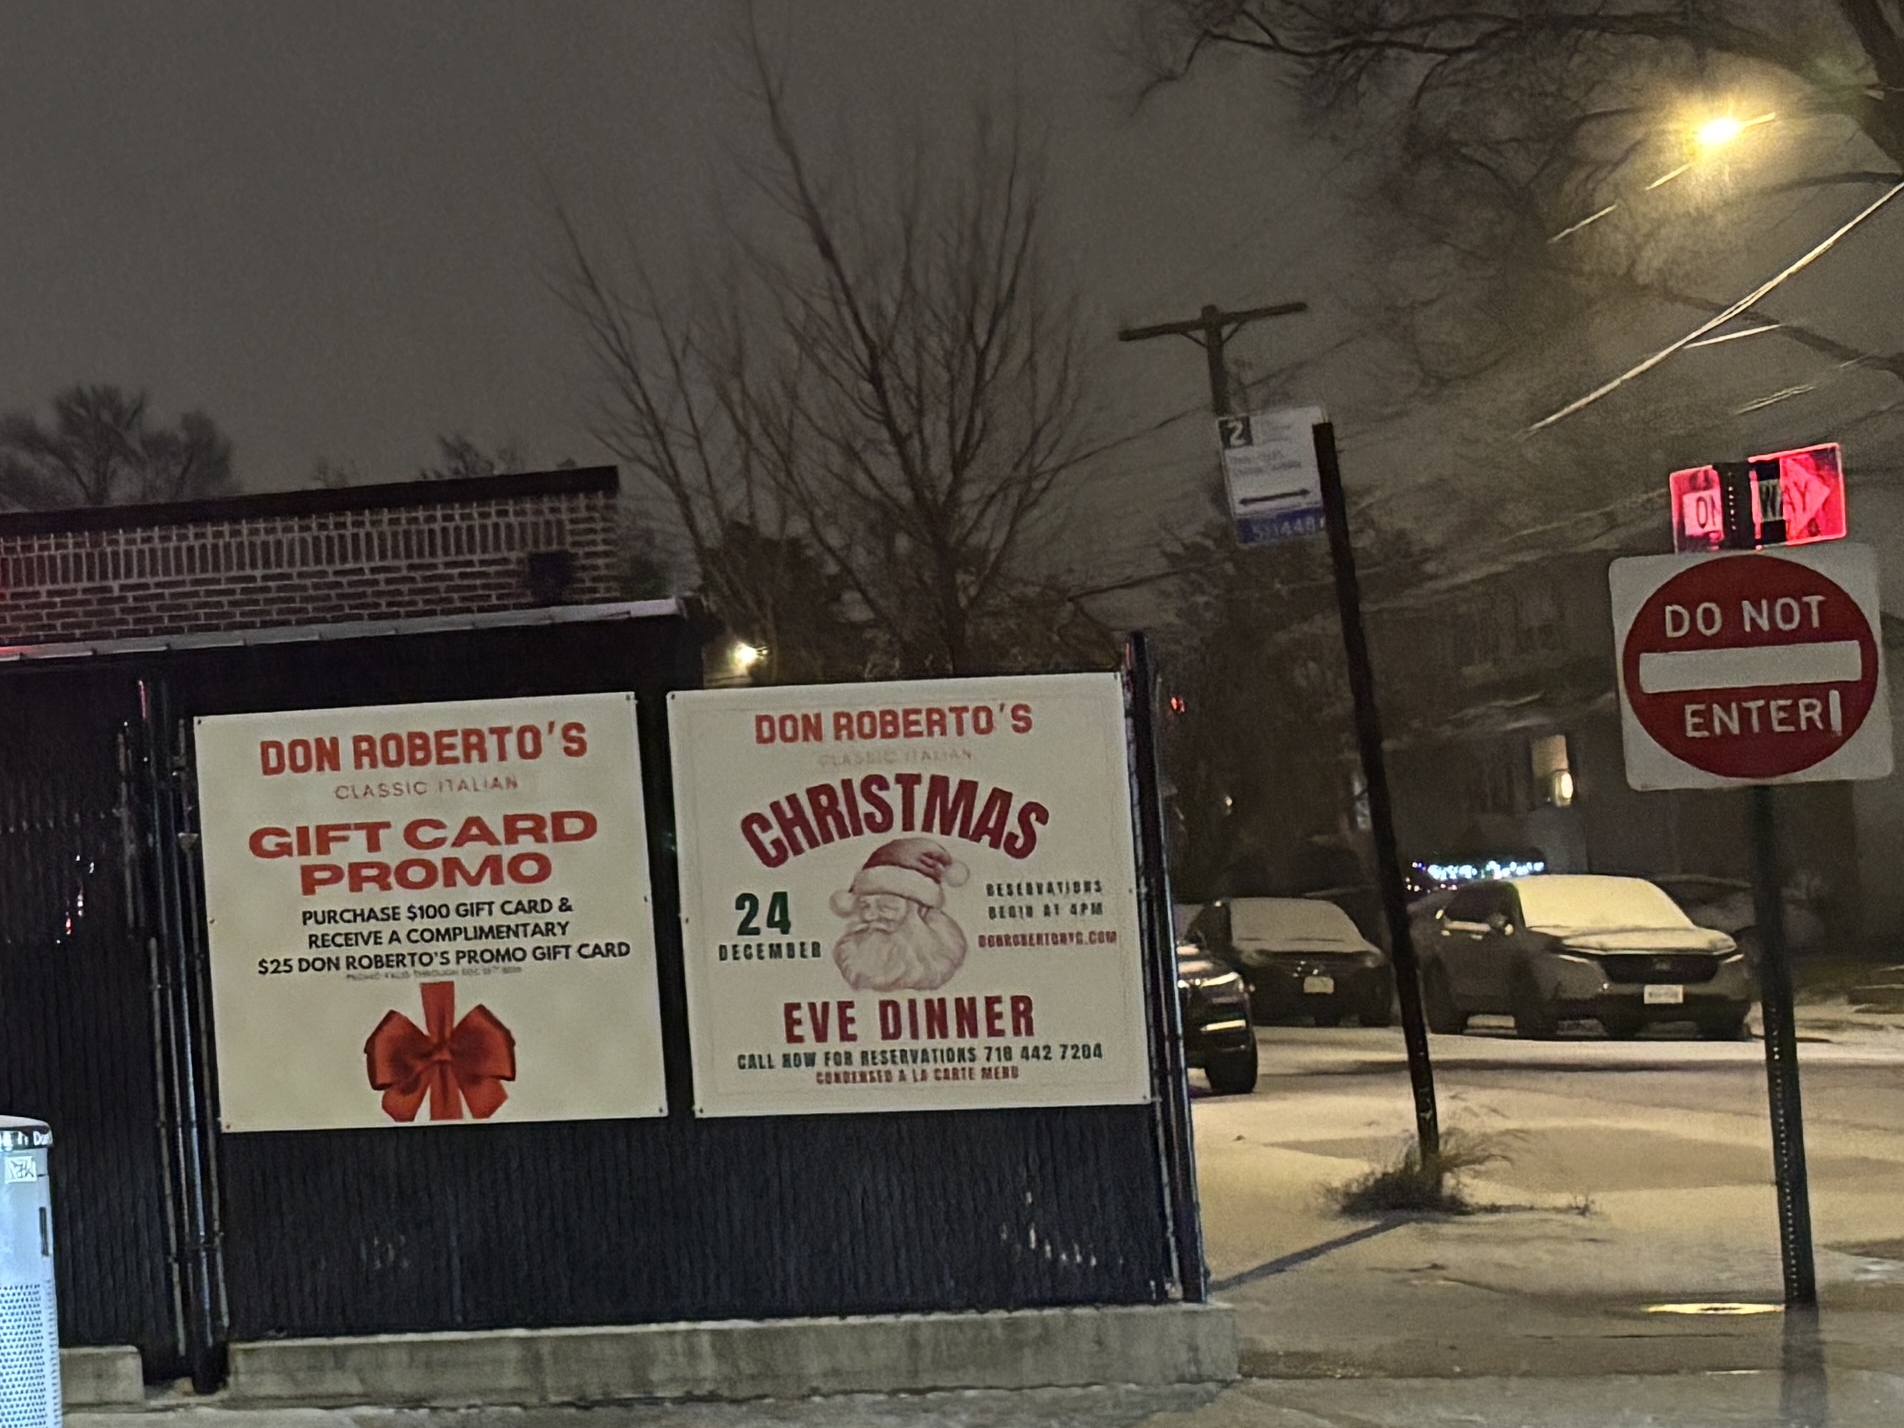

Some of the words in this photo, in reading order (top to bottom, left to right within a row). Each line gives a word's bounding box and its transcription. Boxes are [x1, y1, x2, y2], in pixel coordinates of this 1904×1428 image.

[1226, 420, 1248, 447] 2
[1664, 601, 1722, 639] DO
[1741, 594, 1826, 633] NOT
[755, 711, 824, 745] DON
[834, 703, 1034, 742] ROBERTO'S
[1684, 697, 1824, 738] ENTER
[259, 735, 341, 776] DON
[352, 721, 588, 771] ROBERTO'S
[334, 780, 428, 800] CLASSIC
[436, 775, 520, 795] ITALIAN
[248, 821, 392, 860] GIFT
[403, 810, 598, 850] CARD
[740, 773, 1050, 869] CHRISTMAS
[300, 852, 552, 896] PROMO
[986, 880, 1103, 897] RESERVATIONS
[302, 902, 401, 926] PURCHASE
[406, 901, 450, 922] $100
[456, 899, 496, 918] GIFT
[500, 898, 553, 916] CARD
[558, 896, 574, 913] &
[735, 891, 791, 936] 24
[1043, 903, 1060, 917] AT
[308, 929, 385, 950] RECEIVE
[388, 929, 401, 946] A
[406, 921, 570, 944] COMPLIMENTARY
[718, 941, 821, 961] DECEMBER
[257, 957, 294, 976] $25
[298, 955, 341, 973] DON
[345, 949, 450, 971] ROBERTO'S
[455, 947, 527, 967] PROMO
[532, 944, 572, 962] GIFT
[576, 941, 631, 959] CARD
[783, 1000, 858, 1044] EVE
[878, 994, 1035, 1042] DINNER
[737, 1053, 776, 1071] CALL
[781, 1051, 817, 1069] NOW
[824, 1050, 854, 1068] FOR
[860, 1046, 977, 1067] RESERVATIONS
[984, 1045, 1013, 1063] 718
[1020, 1044, 1053, 1062] 442
[816, 1068, 893, 1085] CONDENSED
[898, 1068, 907, 1082] A
[913, 1067, 929, 1082] LA
[934, 1065, 976, 1082] CARTE
[981, 1064, 1020, 1080] MENU
